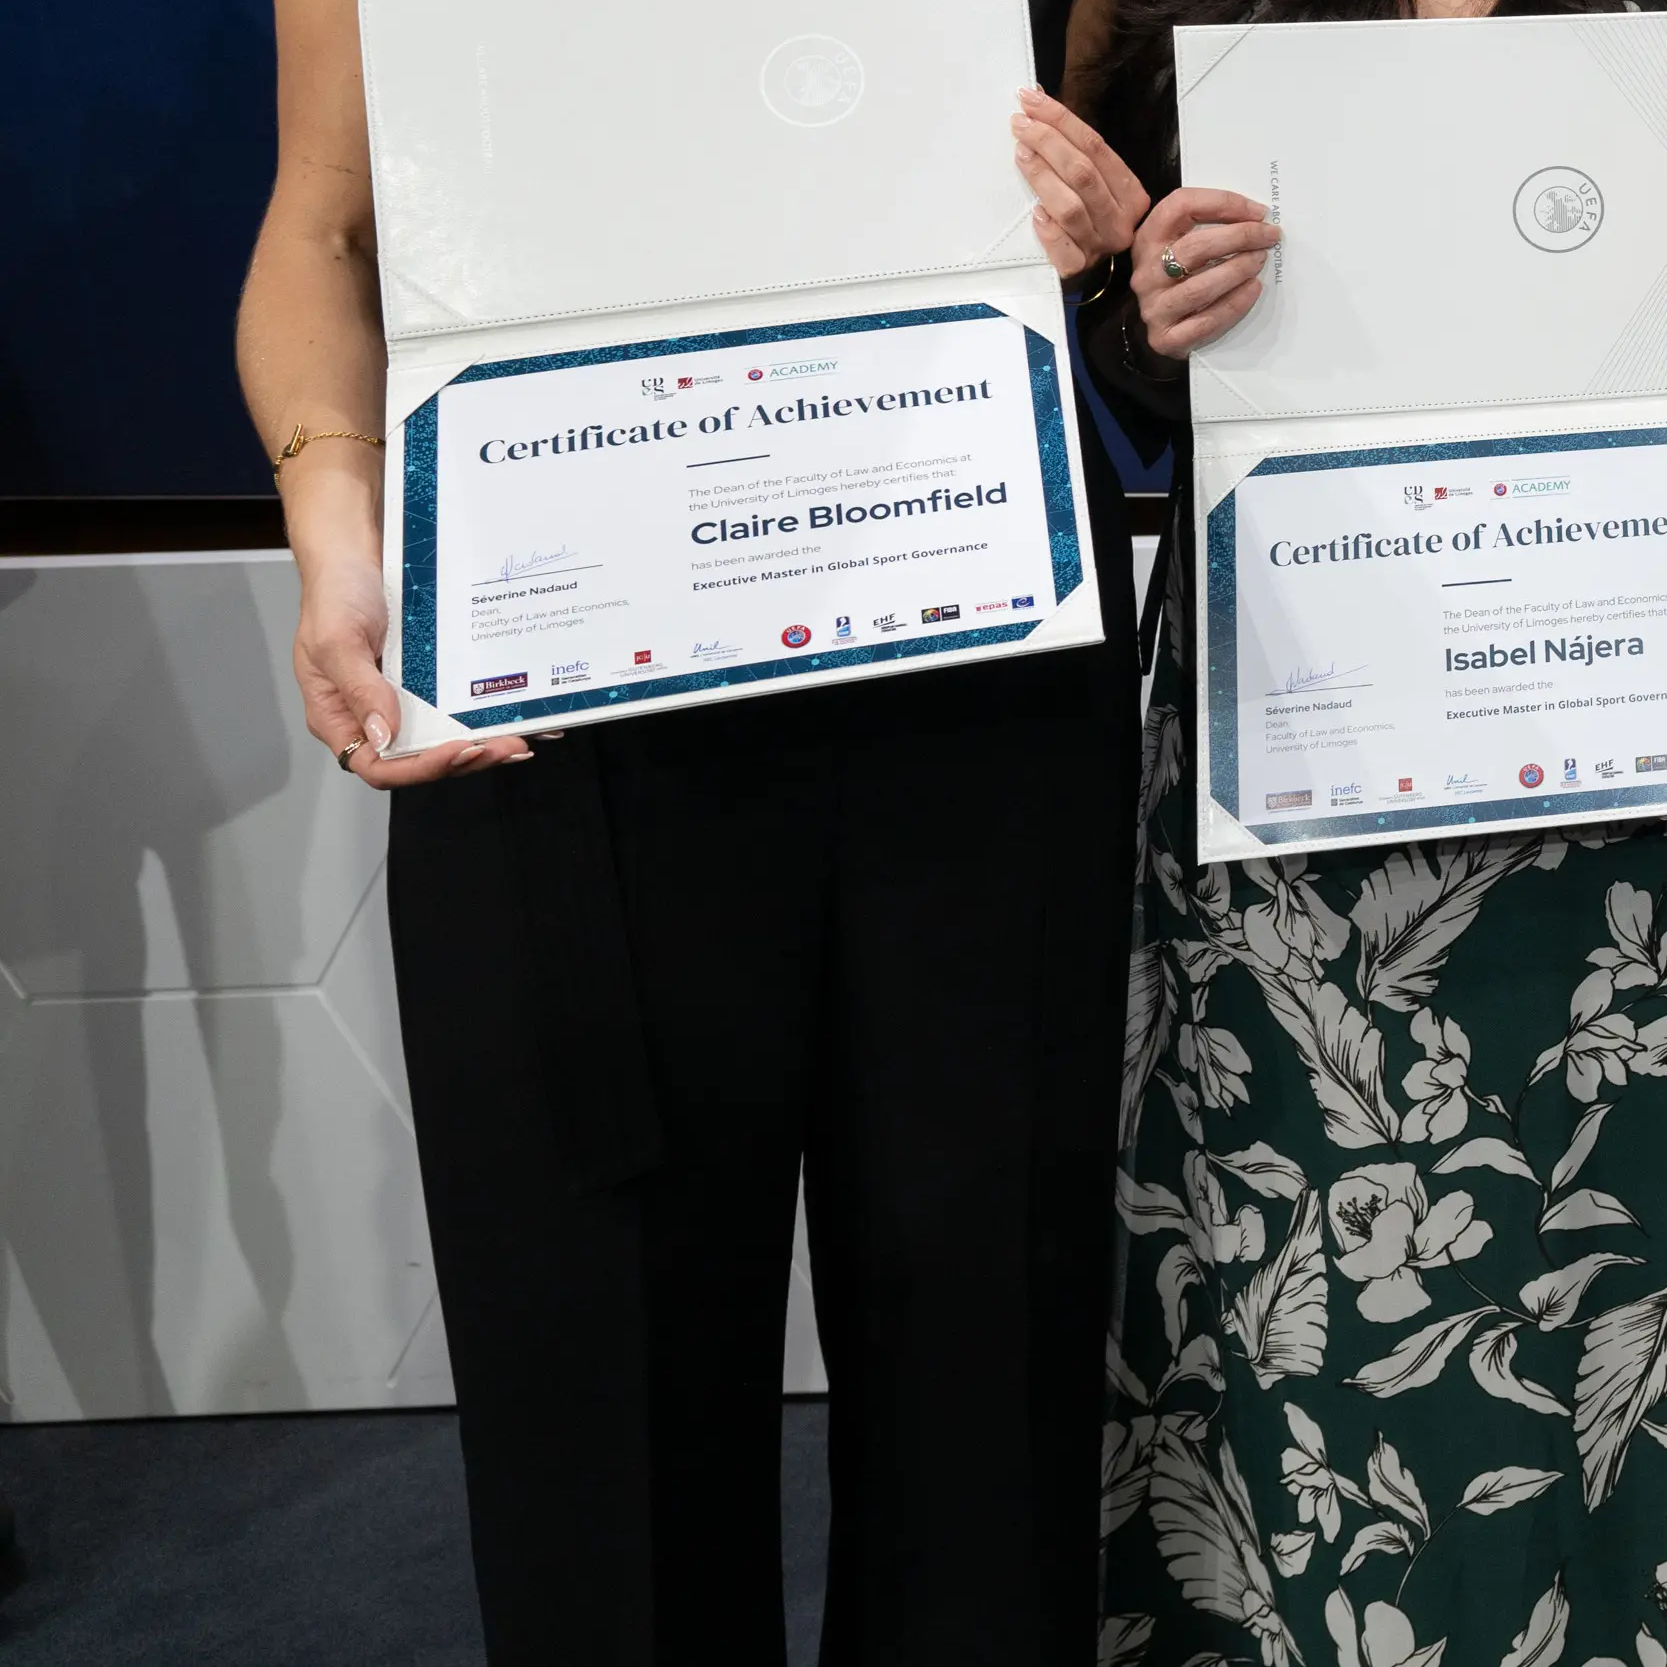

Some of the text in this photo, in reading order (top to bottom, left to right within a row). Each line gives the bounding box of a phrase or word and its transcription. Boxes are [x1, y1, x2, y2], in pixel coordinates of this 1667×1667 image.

[1578, 182, 1597, 232] UEFA
[1270, 160, 1283, 285] WE CARE ABO OOTBALL
[769, 361, 837, 377] ACADEMY
[478, 378, 991, 463] Certificate of Achievement
[1512, 480, 1570, 493] ACADEMY
[690, 481, 1007, 544] Claire Bloomfield
[1269, 532, 1442, 567] Certificate
[1451, 522, 1487, 551] of
[691, 545, 821, 571] has been awarded the
[692, 542, 987, 591] Executive Master in Global Sport Governance
[470, 581, 577, 604] Séverine Nadaud
[979, 599, 1009, 613] epas
[872, 613, 895, 628] EHF
[1445, 634, 1643, 672] Isabel Nájera
[551, 660, 589, 676] inefc
[483, 675, 525, 689] Birkbeck
[1445, 680, 1553, 698] has been awarded the
[1265, 699, 1352, 716] Séverine Nadaud
[1446, 706, 1500, 719] Executive
[1502, 704, 1542, 714] Master
[1544, 701, 1555, 710] in
[1558, 697, 1593, 709] Global
[1595, 695, 1625, 707] Sport
